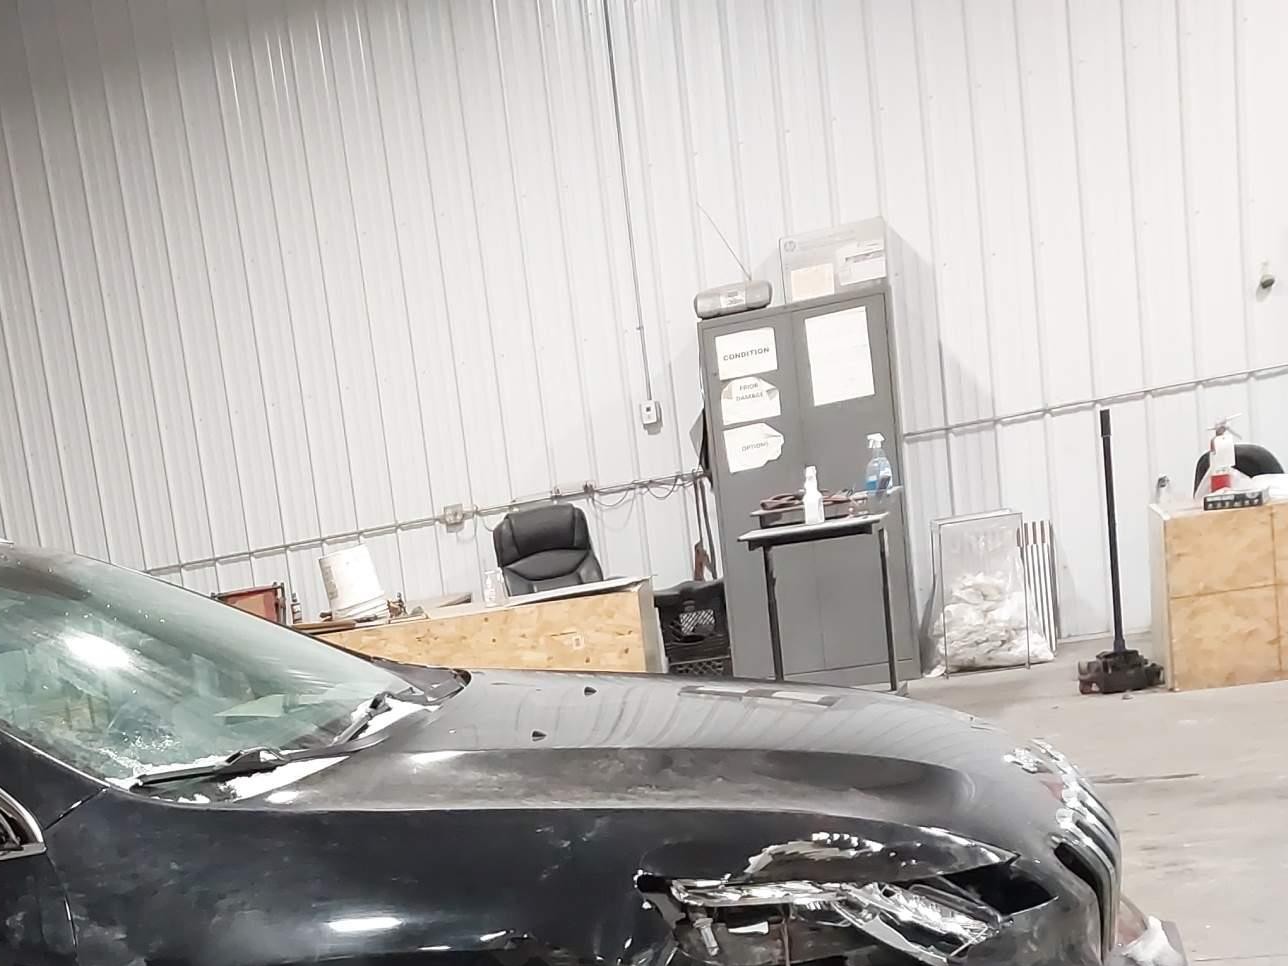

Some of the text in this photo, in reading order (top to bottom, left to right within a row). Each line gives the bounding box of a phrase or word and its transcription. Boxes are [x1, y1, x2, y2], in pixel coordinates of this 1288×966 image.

[723, 347, 770, 361] CONDITION
[739, 382, 759, 391] PRIOR
[735, 391, 764, 402] DAMAGE
